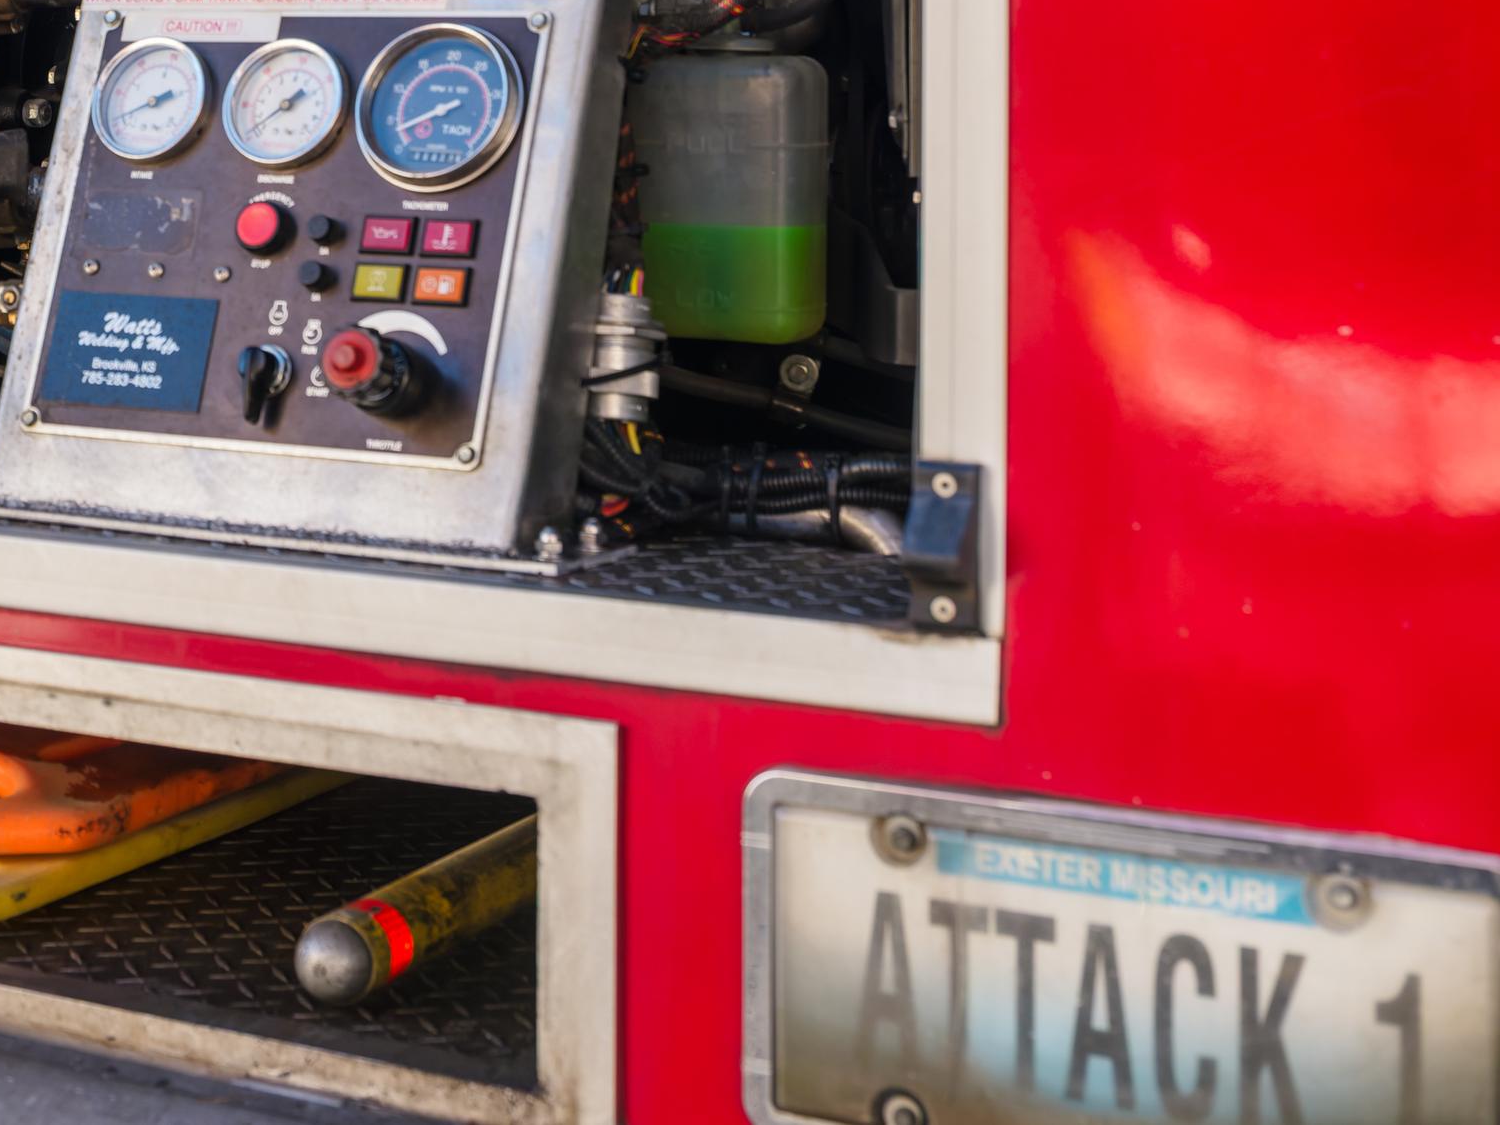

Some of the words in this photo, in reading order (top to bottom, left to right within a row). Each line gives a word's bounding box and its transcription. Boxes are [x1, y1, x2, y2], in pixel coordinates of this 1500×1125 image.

[165, 20, 223, 33] CAUTION
[446, 50, 462, 60] 20
[418, 59, 429, 69] 15
[474, 60, 489, 71] 25
[442, 124, 472, 136] TACH
[402, 201, 449, 212] TACHOMETER
[251, 259, 271, 269] STOP
[103, 311, 163, 336] Watts
[268, 326, 284, 336] OFF
[78, 330, 130, 353] Welding
[131, 335, 145, 350] &
[301, 345, 318, 356] RUN
[91, 356, 140, 373] Brookville,
[141, 360, 157, 373] KS
[306, 387, 330, 397] START
[366, 438, 403, 452] THROTTLE
[974, 841, 1107, 889] EXETER
[1108, 857, 1279, 914] MISSOURI
[857, 889, 1308, 1125] ATTACK
[1375, 971, 1423, 1125] 1
